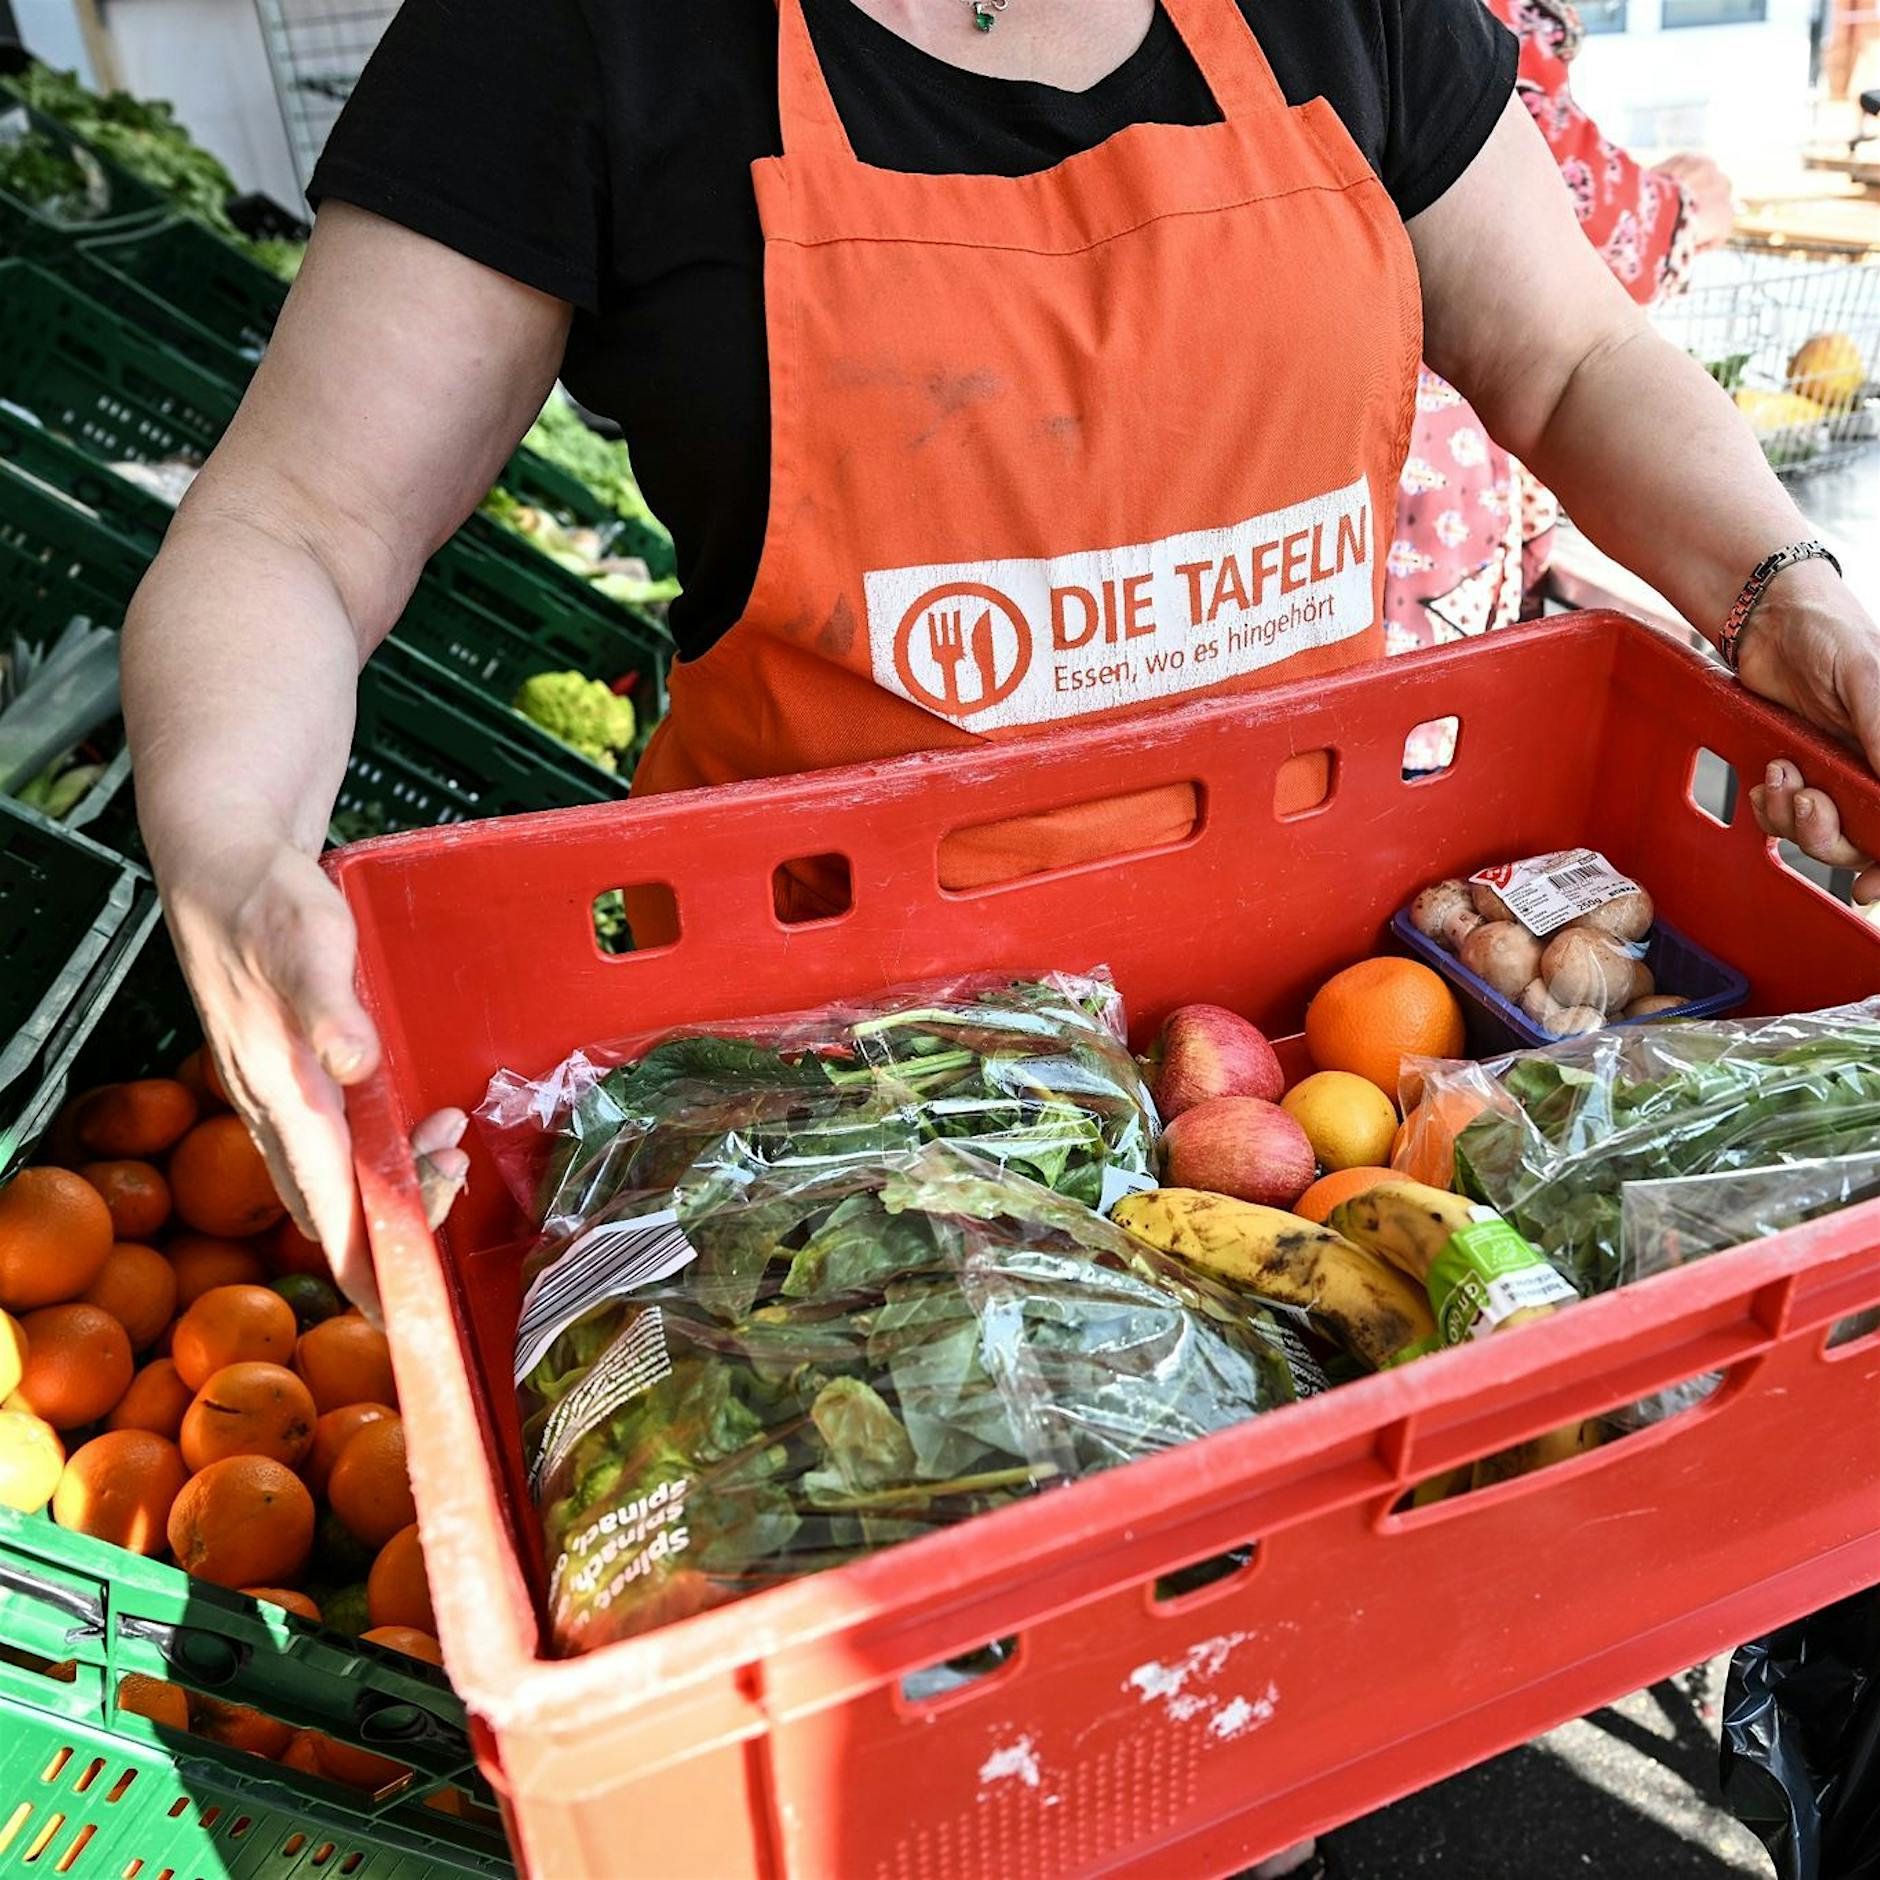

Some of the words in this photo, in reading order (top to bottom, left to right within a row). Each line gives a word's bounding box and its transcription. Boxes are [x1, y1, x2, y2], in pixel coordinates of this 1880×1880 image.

[1049, 571, 1156, 652] DIE
[1174, 504, 1367, 627] TAFELN
[1054, 660, 1137, 693] Essen,
[1145, 649, 1185, 676] wo
[1194, 639, 1219, 664] es
[1228, 593, 1335, 654] hingehört
[1576, 897, 1603, 912] 250g
